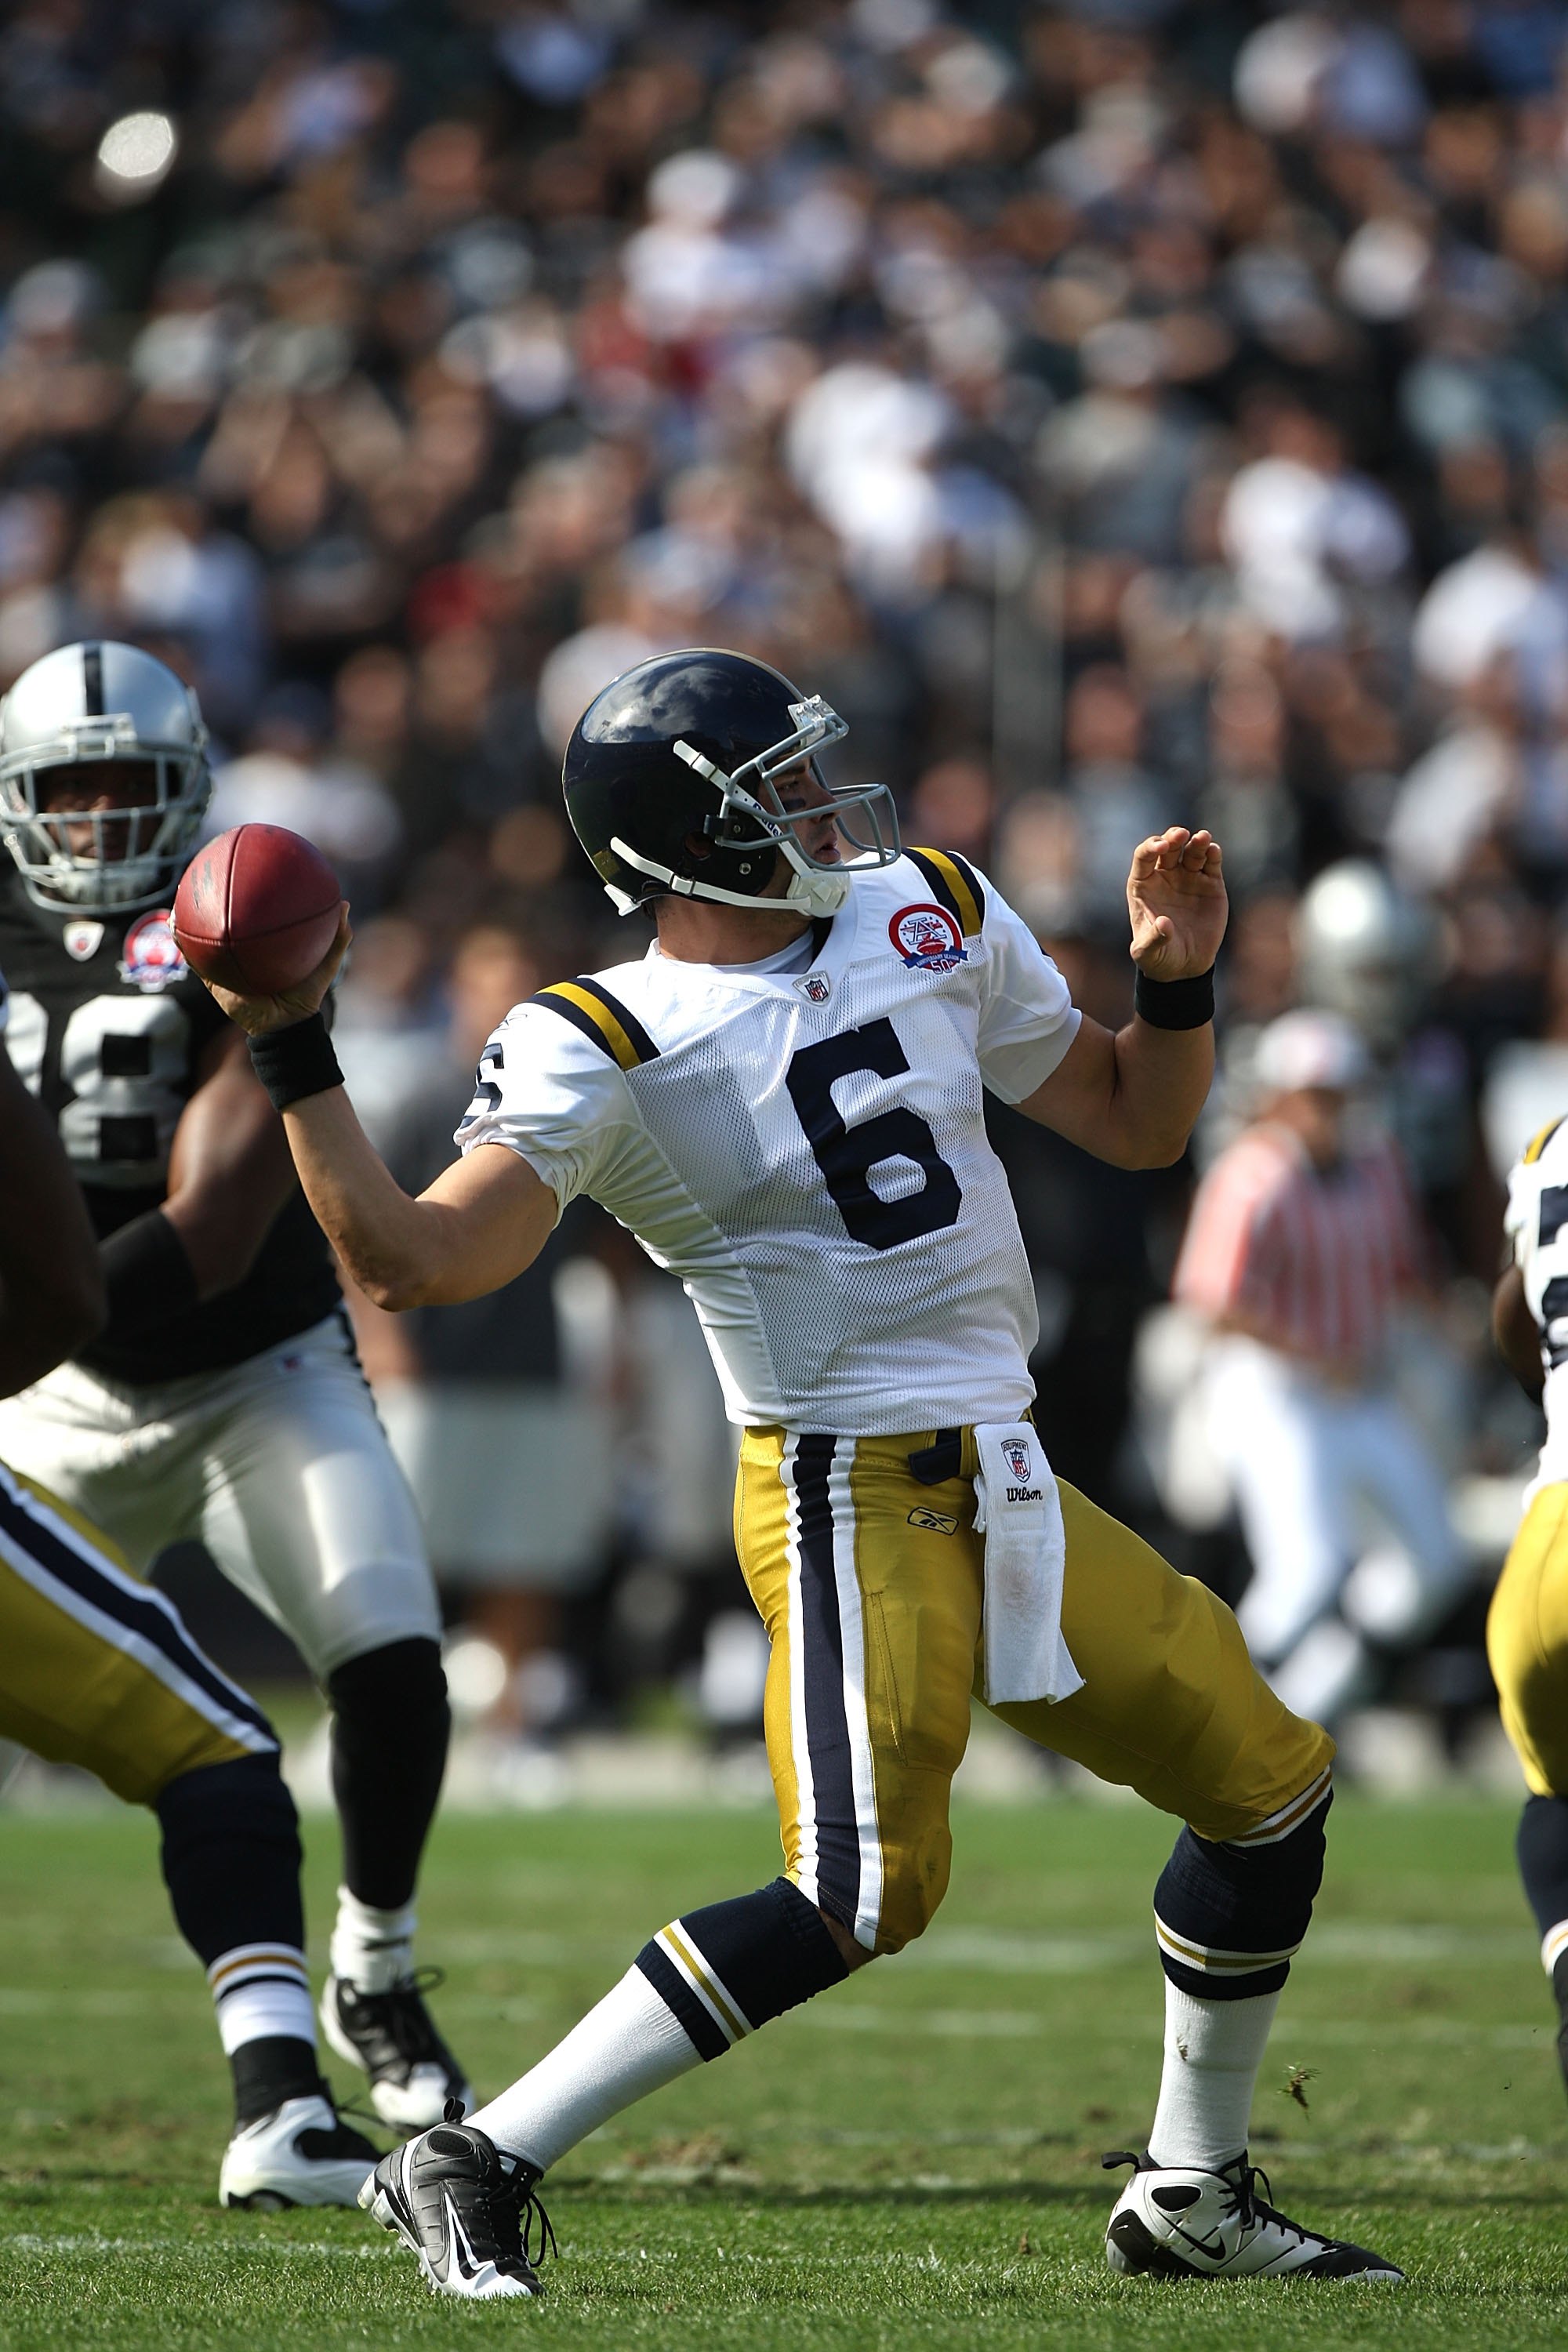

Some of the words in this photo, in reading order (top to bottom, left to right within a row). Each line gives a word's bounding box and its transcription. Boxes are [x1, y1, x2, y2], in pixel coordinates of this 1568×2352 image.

[786, 1017, 962, 1251] 6
[1003, 1441, 1028, 1452] EQUIPMENT
[1013, 1461, 1027, 1475] NFL
[1006, 1486, 1042, 1502] Wilson
